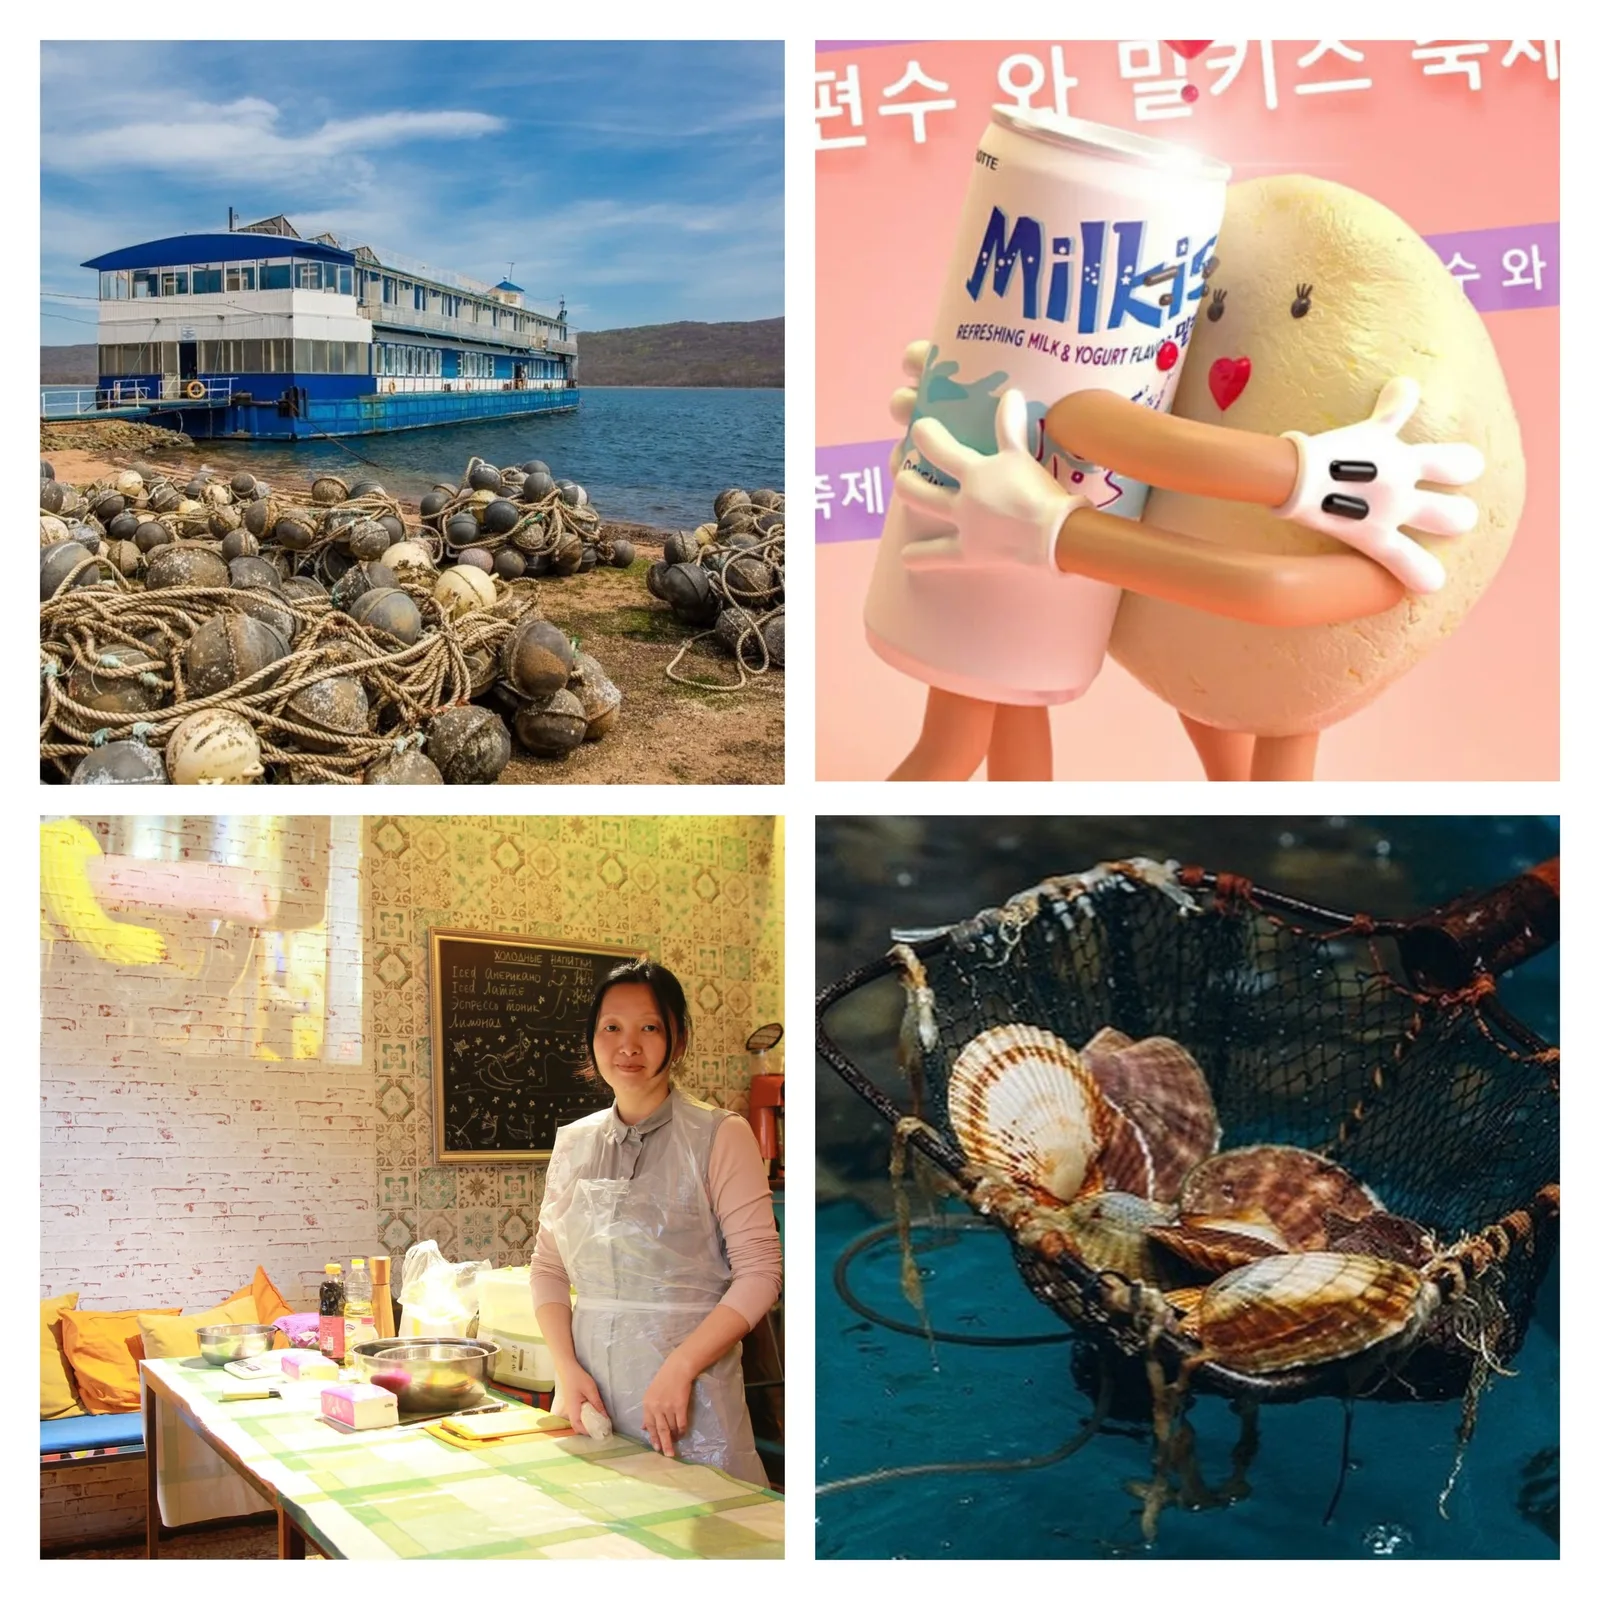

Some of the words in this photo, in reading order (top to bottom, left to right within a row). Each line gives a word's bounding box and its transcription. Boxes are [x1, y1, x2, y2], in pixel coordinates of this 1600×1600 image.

[815, 60, 957, 149] 편수
[995, 45, 1079, 117] 와
[1501, 244, 1547, 291] 와
[956, 324, 1025, 348] REFRESHING
[1027, 333, 1060, 357] MILK
[1060, 347, 1070, 362] &
[1075, 346, 1128, 366] YOGURT
[494, 951, 543, 965] ХОЛОДНЫЕ
[551, 954, 592, 968] НАПИТКИ
[449, 1014, 502, 1029] Лимонад
